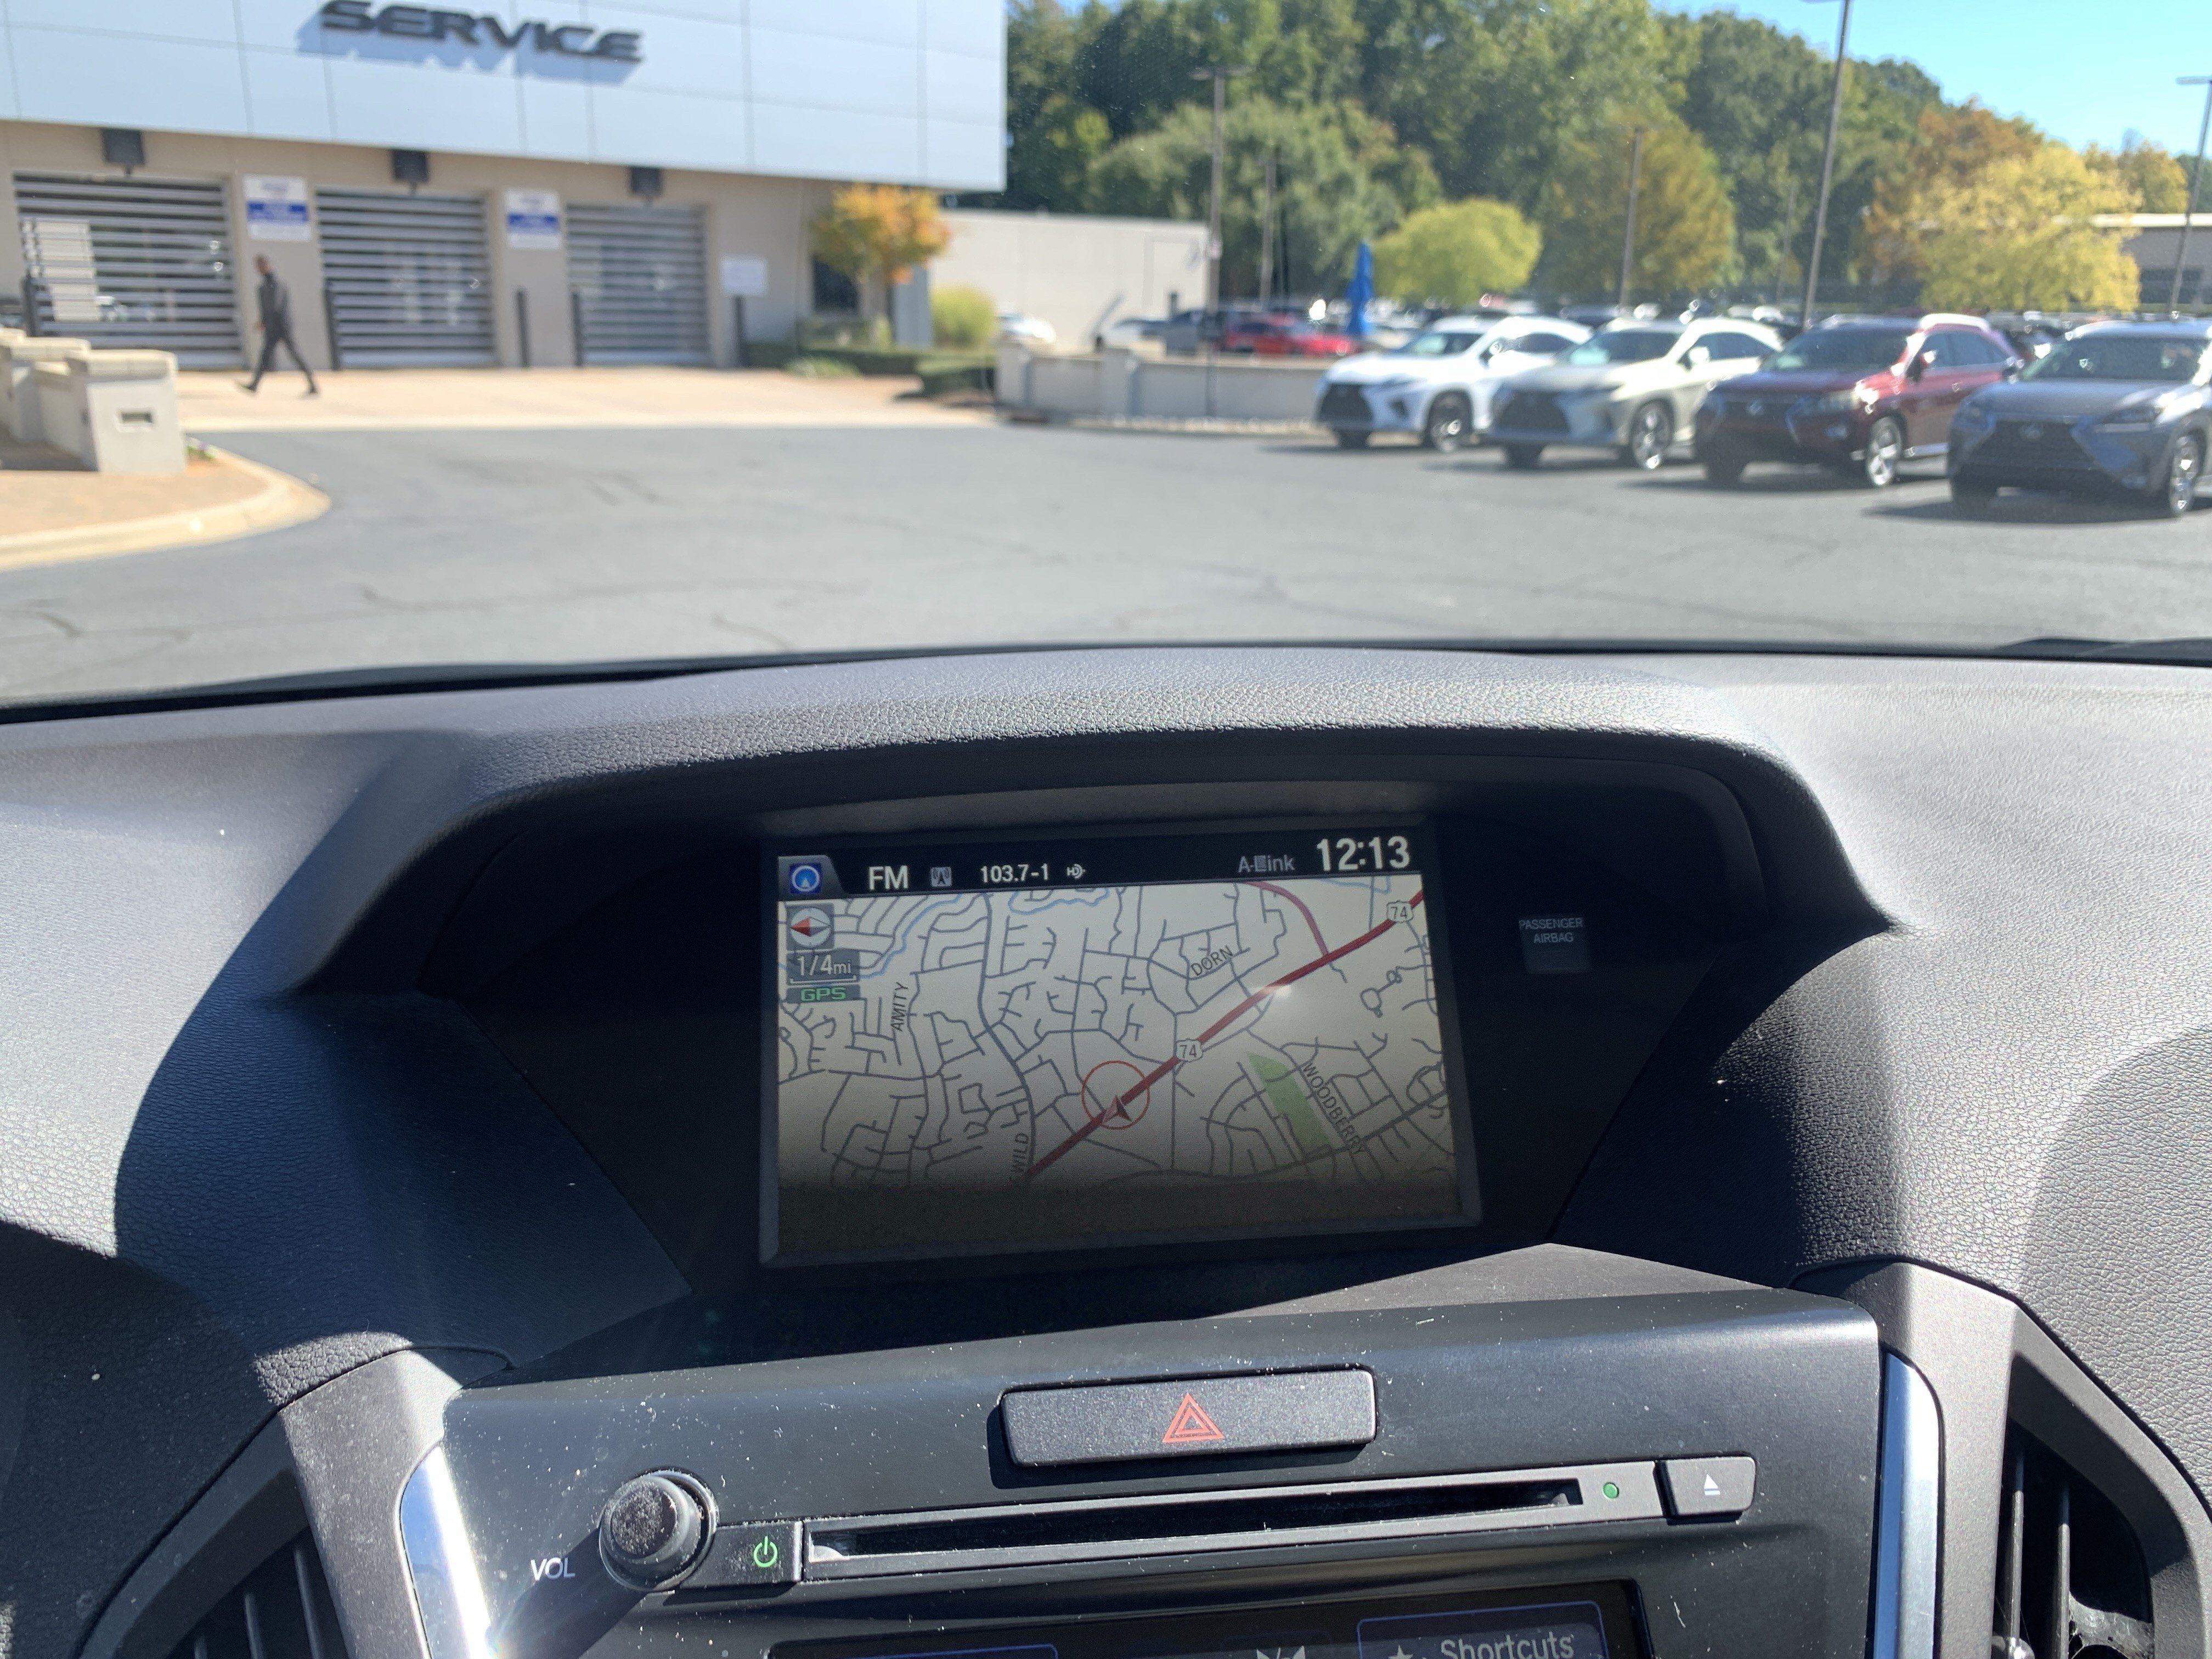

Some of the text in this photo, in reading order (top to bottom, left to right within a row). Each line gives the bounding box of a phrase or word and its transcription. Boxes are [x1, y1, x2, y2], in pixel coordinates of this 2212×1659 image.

[321, 0, 643, 62] SERVICE
[1316, 835, 1410, 872] 12:13
[868, 865, 909, 890] FM
[980, 863, 1048, 883] 103.7-1
[1390, 906, 1408, 920] 74
[1518, 917, 1583, 930] PASSENGER
[1533, 932, 1574, 944] AIRBAG
[1190, 944, 1234, 977] DORN
[800, 987, 847, 1002] GPS
[890, 981, 909, 1032] AMITY
[1180, 1044, 1198, 1058] 74
[1304, 1062, 1366, 1155] WOODBERRY
[530, 1557, 576, 1581] VOL
[1441, 1631, 1575, 1659] Shortcuts
